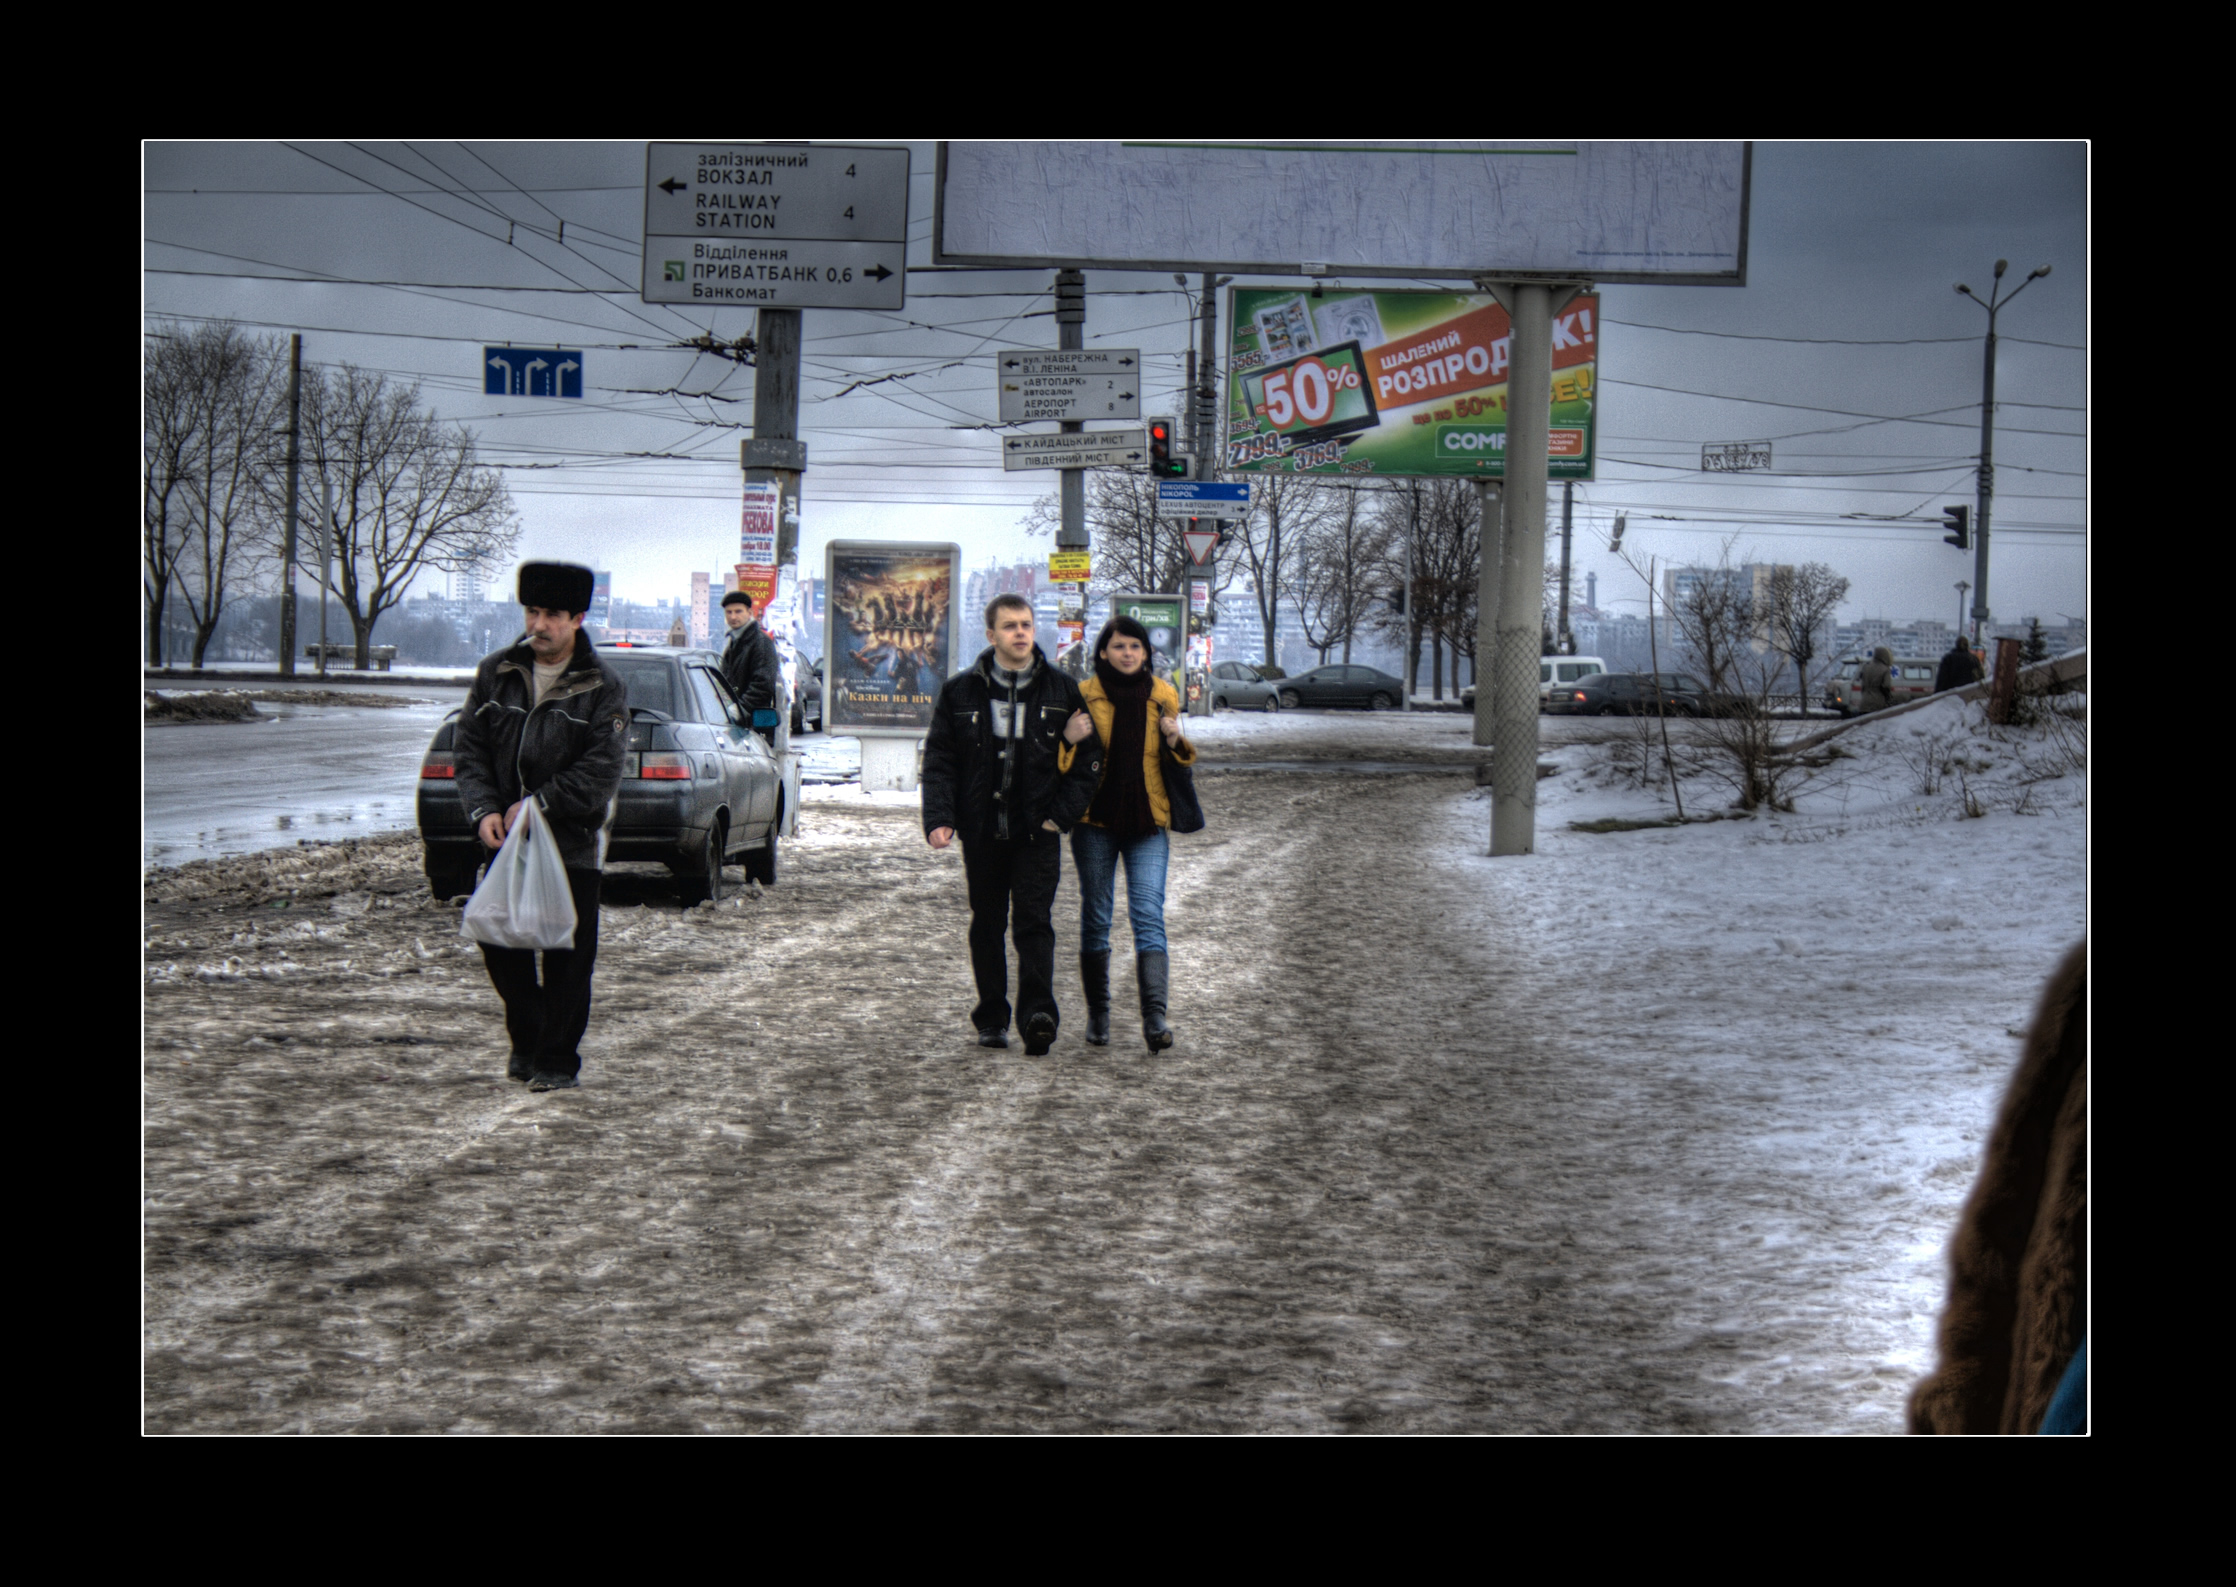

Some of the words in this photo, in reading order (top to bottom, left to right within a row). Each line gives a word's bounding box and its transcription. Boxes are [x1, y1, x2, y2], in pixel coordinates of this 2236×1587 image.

[698, 152, 808, 168] залізничний
[697, 169, 773, 185] ВОКЗАЛ
[845, 163, 856, 178] 4
[696, 193, 781, 210] RAILWAY
[843, 205, 855, 220] 4
[695, 212, 776, 229] STATION
[694, 244, 788, 261] Відділення
[693, 264, 818, 282] ПРИВАТБАНК
[826, 267, 853, 284] 0,6
[692, 283, 777, 299] Банкомат
[1380, 330, 1461, 370] ШАЛЕНИЙ
[1023, 357, 1041, 365] вул.
[1044, 354, 1108, 363] НАБЕРЕЖНА
[1041, 364, 1077, 373] ЛЕНІНА
[1023, 377, 1086, 387] «АВТОПАРК»
[1107, 381, 1114, 389] 2
[1024, 399, 1076, 408] АЕРОПОРТ
[1108, 402, 1114, 411] 8
[1454, 395, 1496, 418] 50%
[1024, 409, 1066, 418] AIRPORT
[1024, 435, 1097, 448] КАЙДАЦЬКИЙ
[1100, 435, 1125, 445] МІСТ
[1444, 432, 1506, 450] COMF
[1025, 453, 1082, 466] ПІВДЕННИЙ
[1085, 453, 1110, 463] МІСТ
[849, 692, 888, 702] Казки
[893, 694, 908, 703] на
[912, 692, 932, 703] ніч
